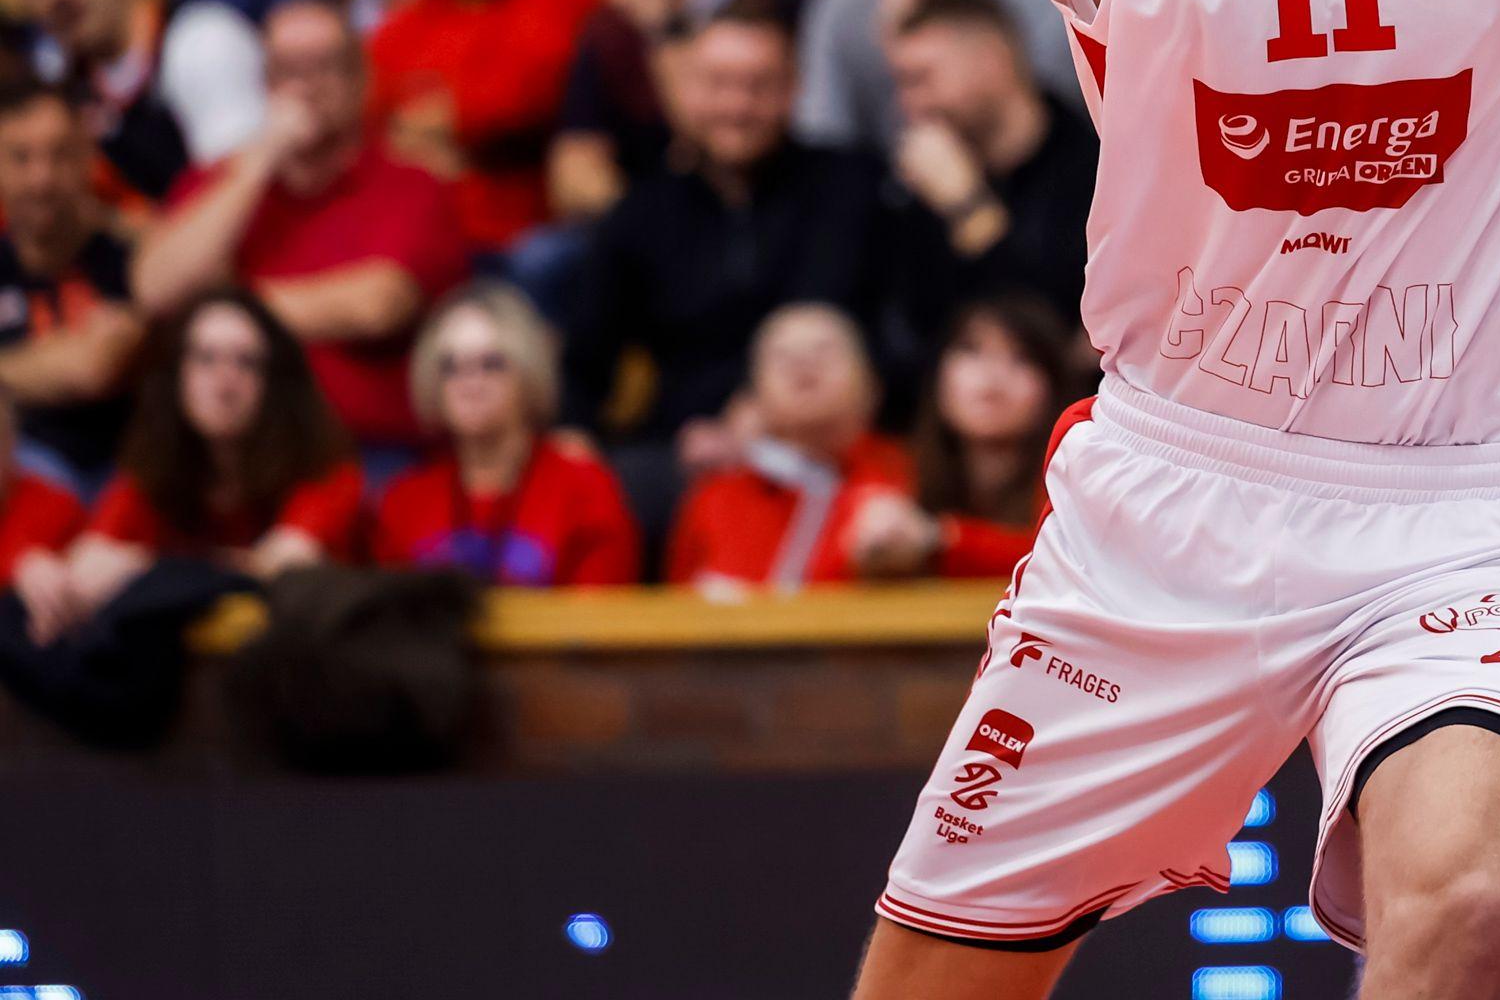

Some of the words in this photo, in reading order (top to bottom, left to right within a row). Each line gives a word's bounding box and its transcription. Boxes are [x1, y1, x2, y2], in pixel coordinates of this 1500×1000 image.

[1285, 110, 1440, 157] Energa
[1284, 165, 1351, 187] GRUPA
[1358, 156, 1433, 181] ORLEN
[1160, 266, 1459, 400] CZARNI
[1046, 656, 1121, 703] FRAGES
[978, 723, 1026, 753] ORLEN
[934, 806, 984, 836] Basket
[936, 823, 969, 844] Liga
